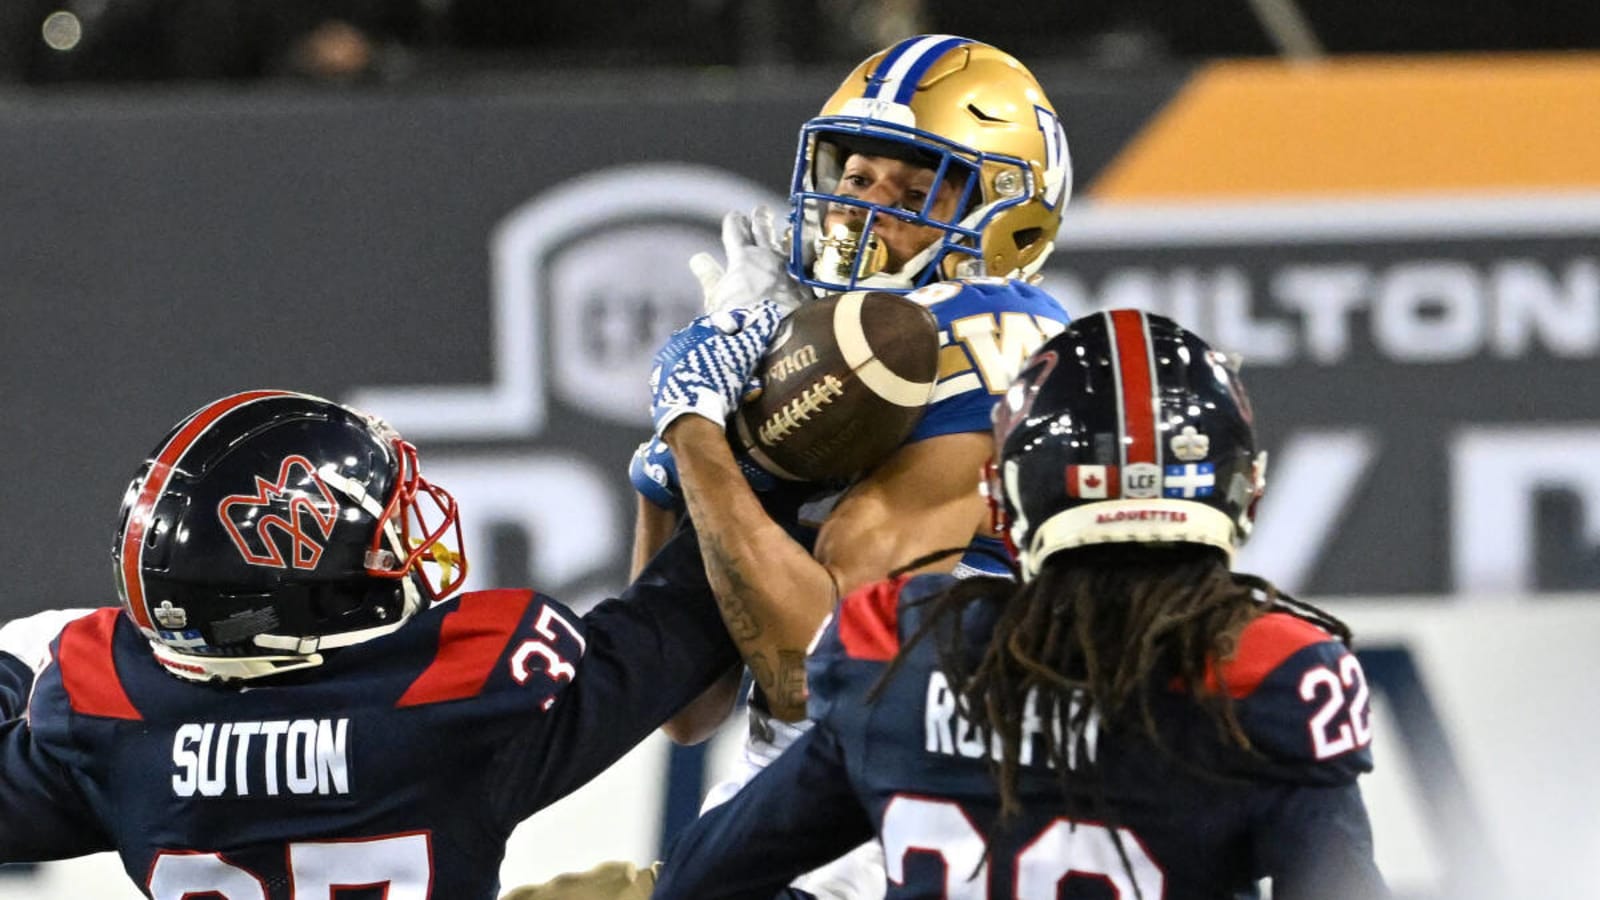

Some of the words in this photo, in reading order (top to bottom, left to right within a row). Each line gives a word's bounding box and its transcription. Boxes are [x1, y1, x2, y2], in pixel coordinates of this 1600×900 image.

[1128, 474, 1156, 489] LCF
[1096, 510, 1188, 524] ALOUETTES
[1299, 652, 1374, 760] 22
[172, 718, 349, 797] SUTTON
